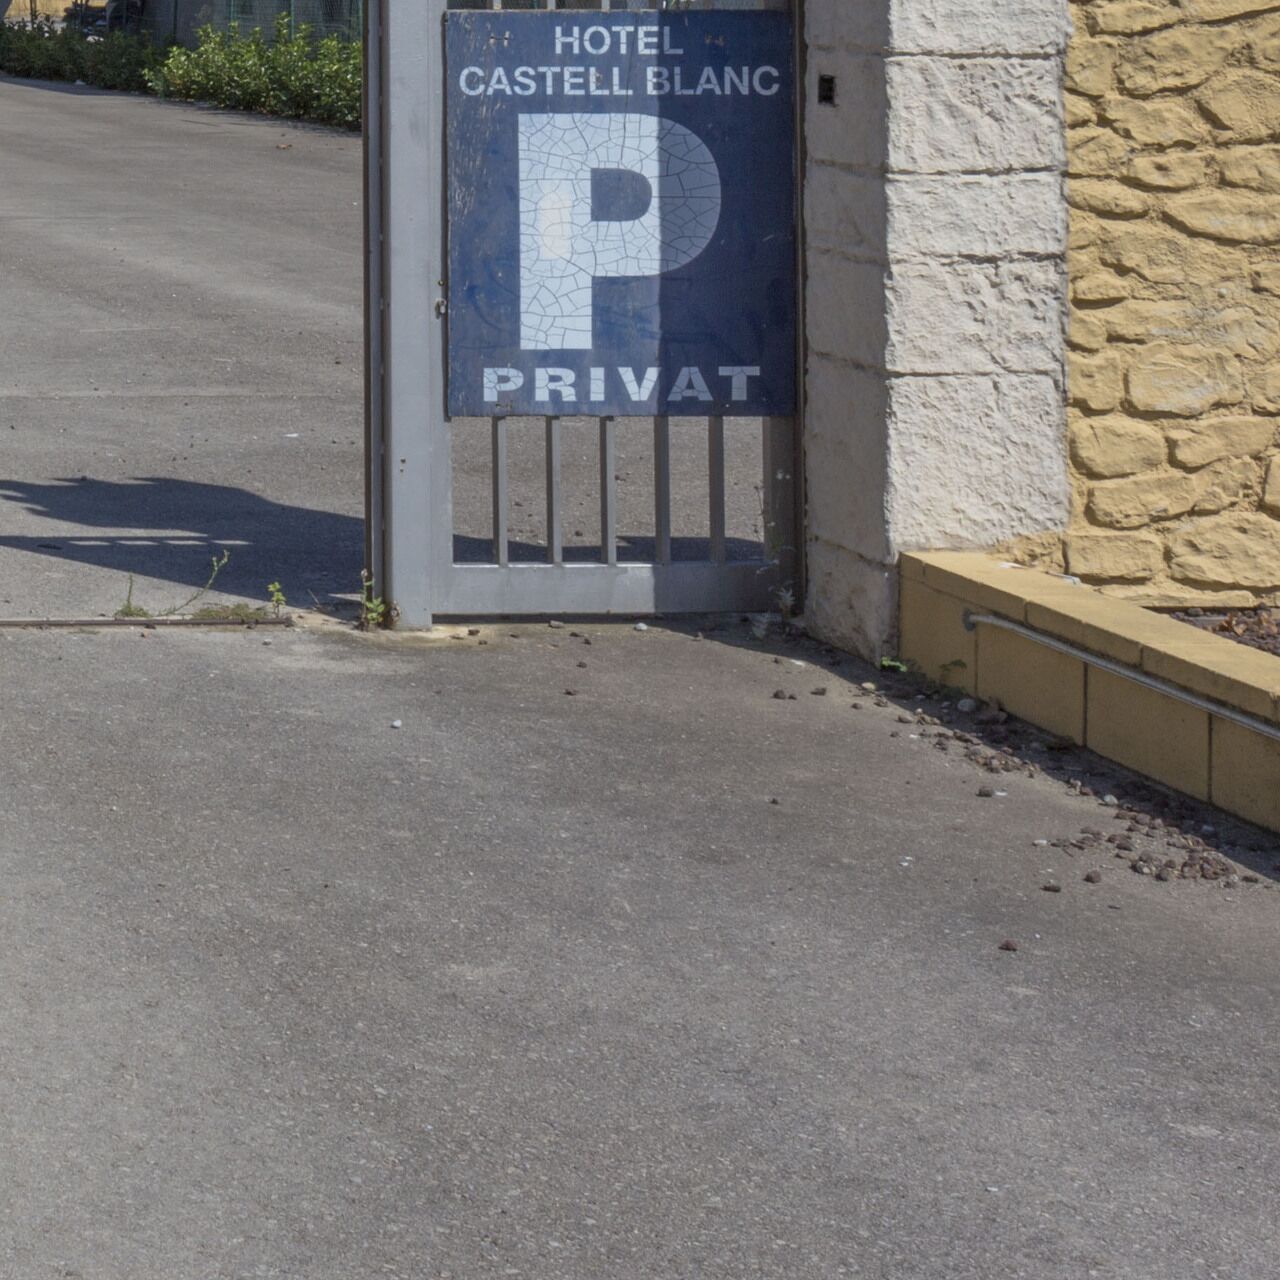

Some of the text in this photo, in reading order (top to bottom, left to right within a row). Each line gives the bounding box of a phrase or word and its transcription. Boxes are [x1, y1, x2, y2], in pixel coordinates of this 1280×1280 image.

[554, 25, 683, 55] HOTEL
[458, 65, 780, 96] CASTELL BLANC
[517, 112, 721, 350] P
[483, 365, 760, 402] PRIVAT
